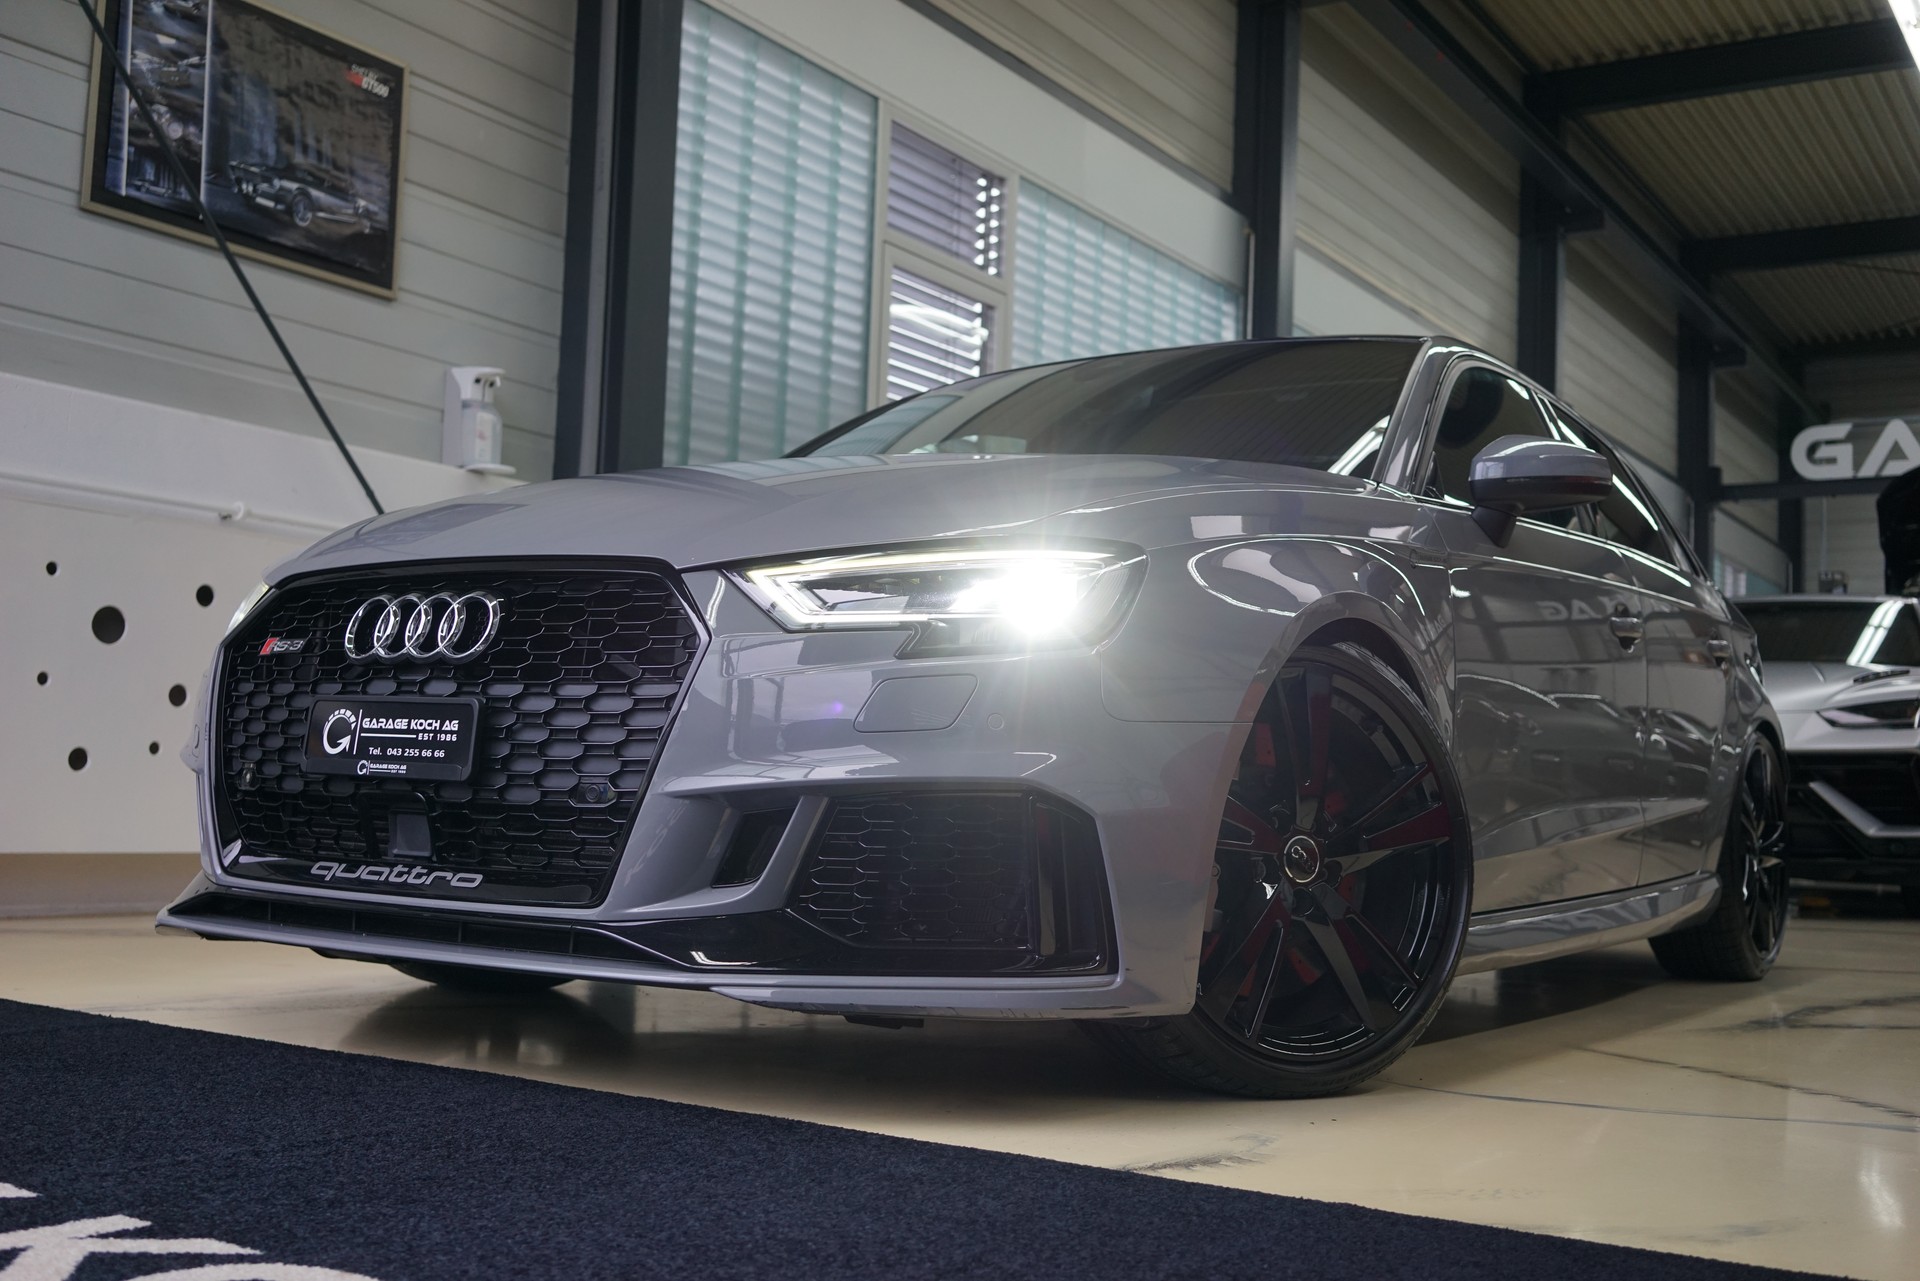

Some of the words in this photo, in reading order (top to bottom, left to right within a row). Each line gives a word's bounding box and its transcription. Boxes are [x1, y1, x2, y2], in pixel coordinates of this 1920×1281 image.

[1790, 418, 1920, 480] GA
[362, 718, 409, 729] GARAGE
[410, 719, 440, 730] KOCH
[442, 720, 459, 731] AG
[369, 747, 382, 755] Tel.
[387, 748, 402, 756] 043
[404, 748, 420, 757] 255
[421, 749, 432, 757] 66
[310, 861, 483, 888] quattro
